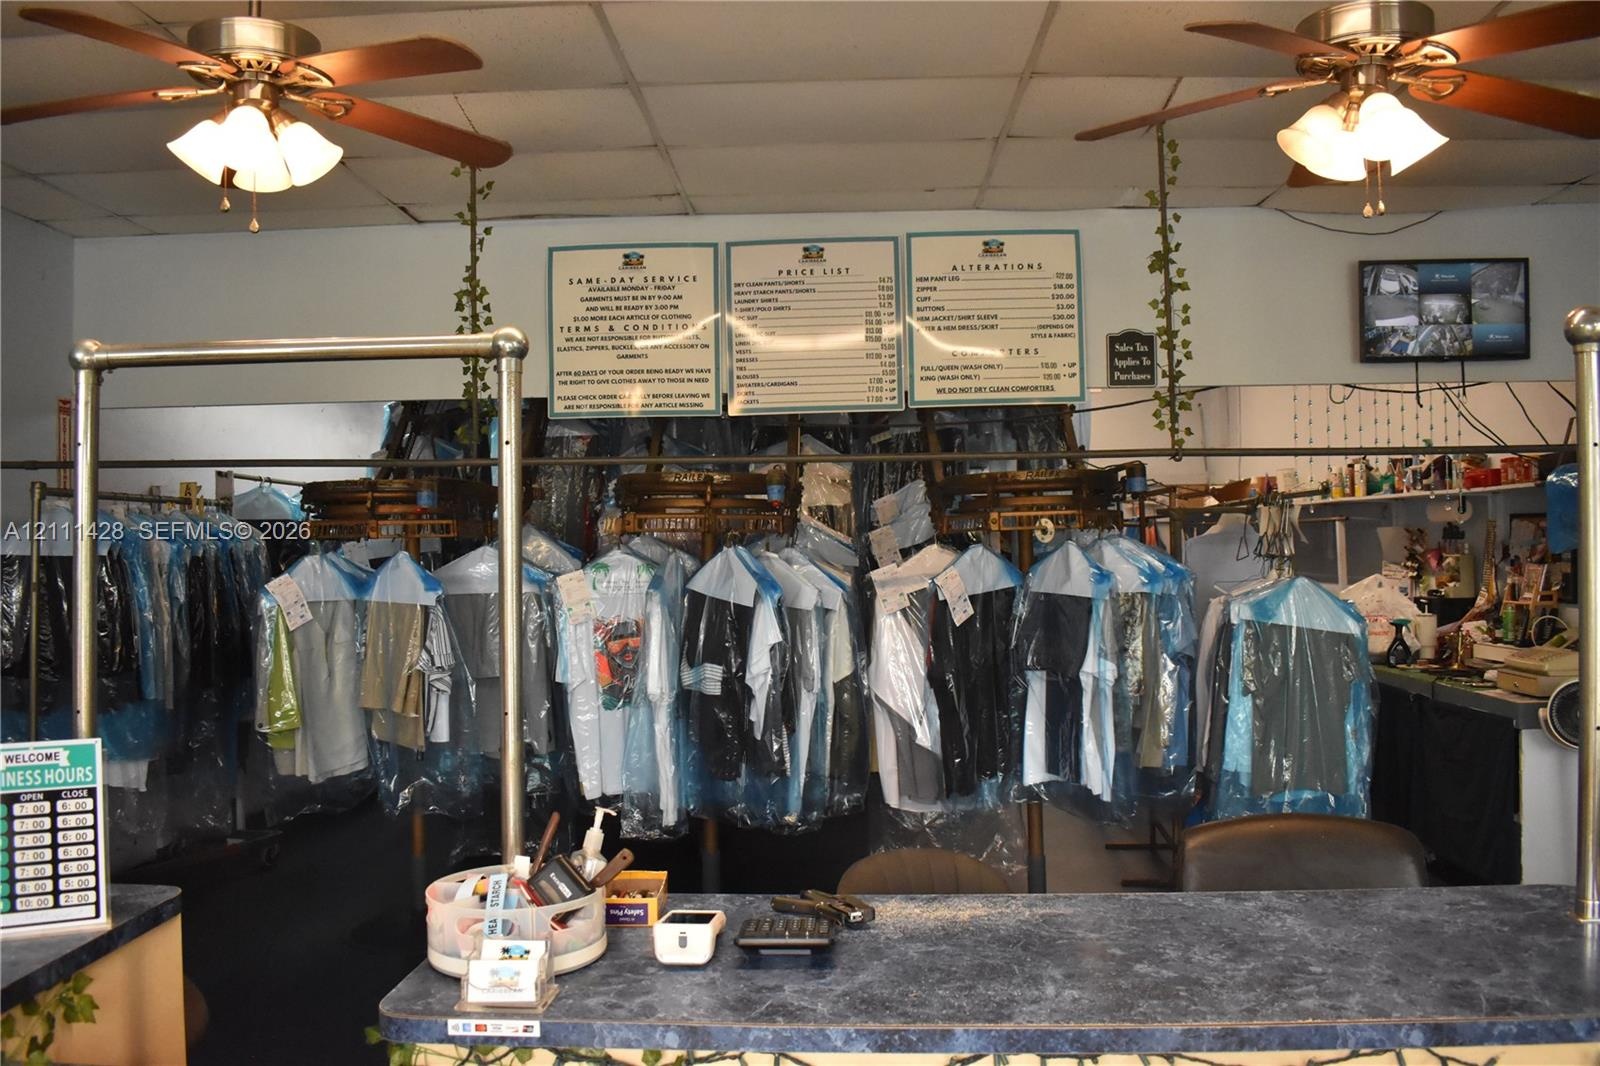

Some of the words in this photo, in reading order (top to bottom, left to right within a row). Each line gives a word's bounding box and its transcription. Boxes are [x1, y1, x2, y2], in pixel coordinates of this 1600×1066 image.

[952, 263, 1042, 271] ALTERATIONS
[569, 277, 634, 285] SAME-DAY
[1115, 343, 1133, 352] Sales
[1135, 343, 1148, 351] Tax
[1114, 357, 1140, 368] Applies
[1142, 357, 1150, 365] To
[1114, 371, 1150, 380] Purchases
[5, 752, 60, 764] WELCOME
[45, 766, 93, 783] HOURS
[62, 789, 88, 798] CLOSE
[490, 880, 502, 908] STARCH
[624, 908, 644, 916] Safety
